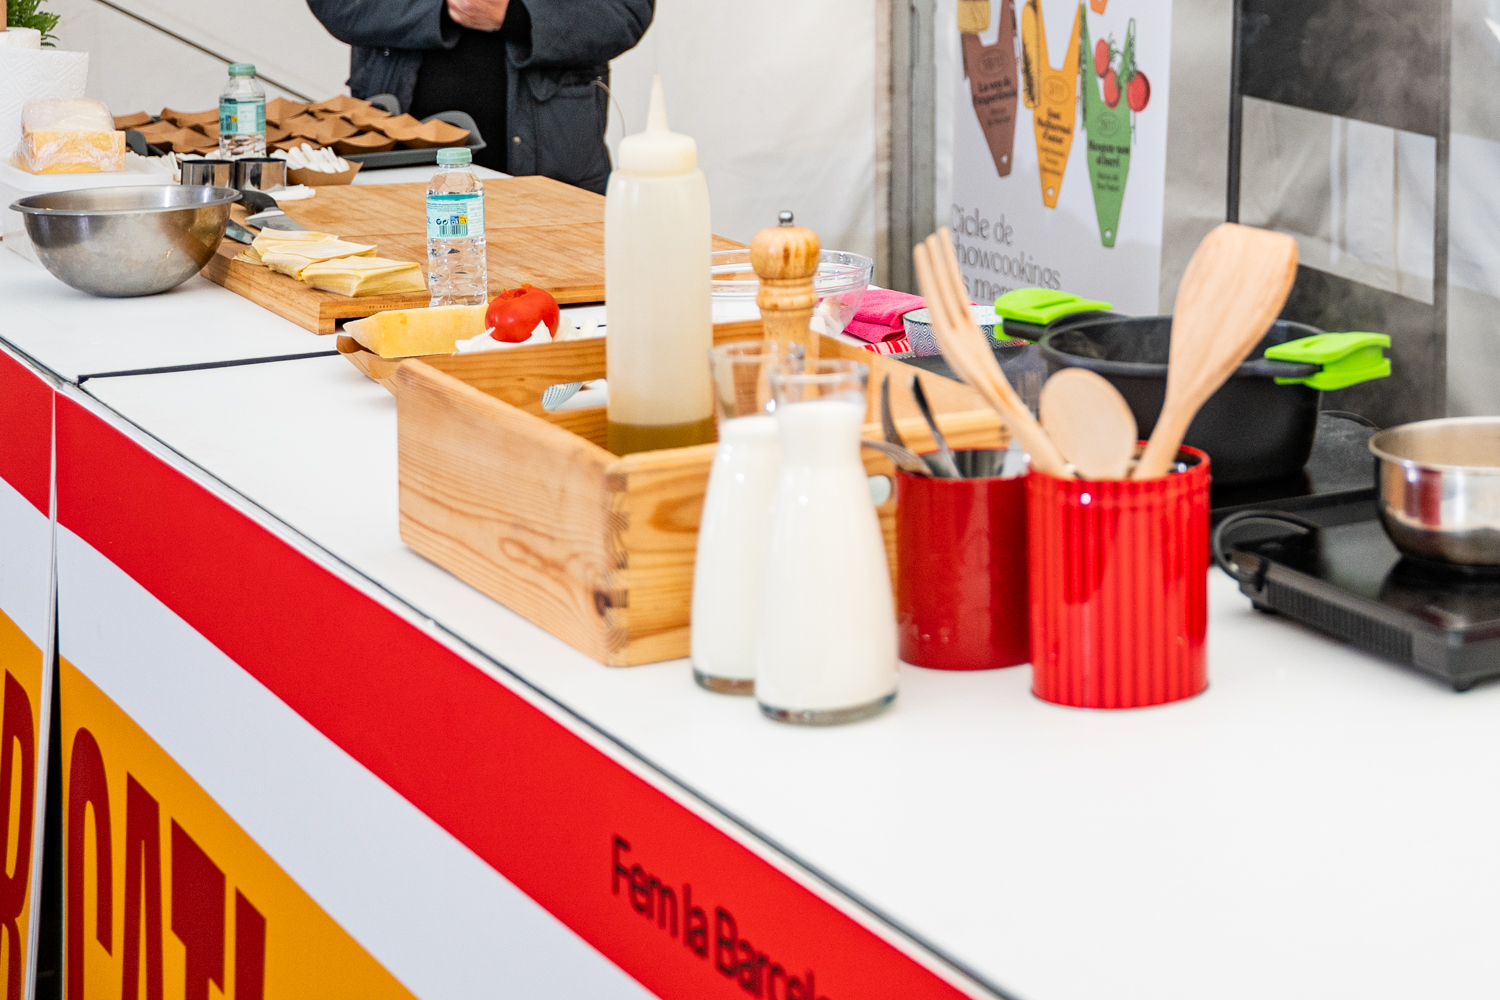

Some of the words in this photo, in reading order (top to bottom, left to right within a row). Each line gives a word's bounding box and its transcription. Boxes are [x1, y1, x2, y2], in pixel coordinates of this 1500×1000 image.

[952, 203, 990, 239] Cicle
[993, 213, 1014, 246] de
[955, 234, 1061, 290] howcookings
[611, 834, 679, 938] Fem
[682, 883, 709, 961] la
